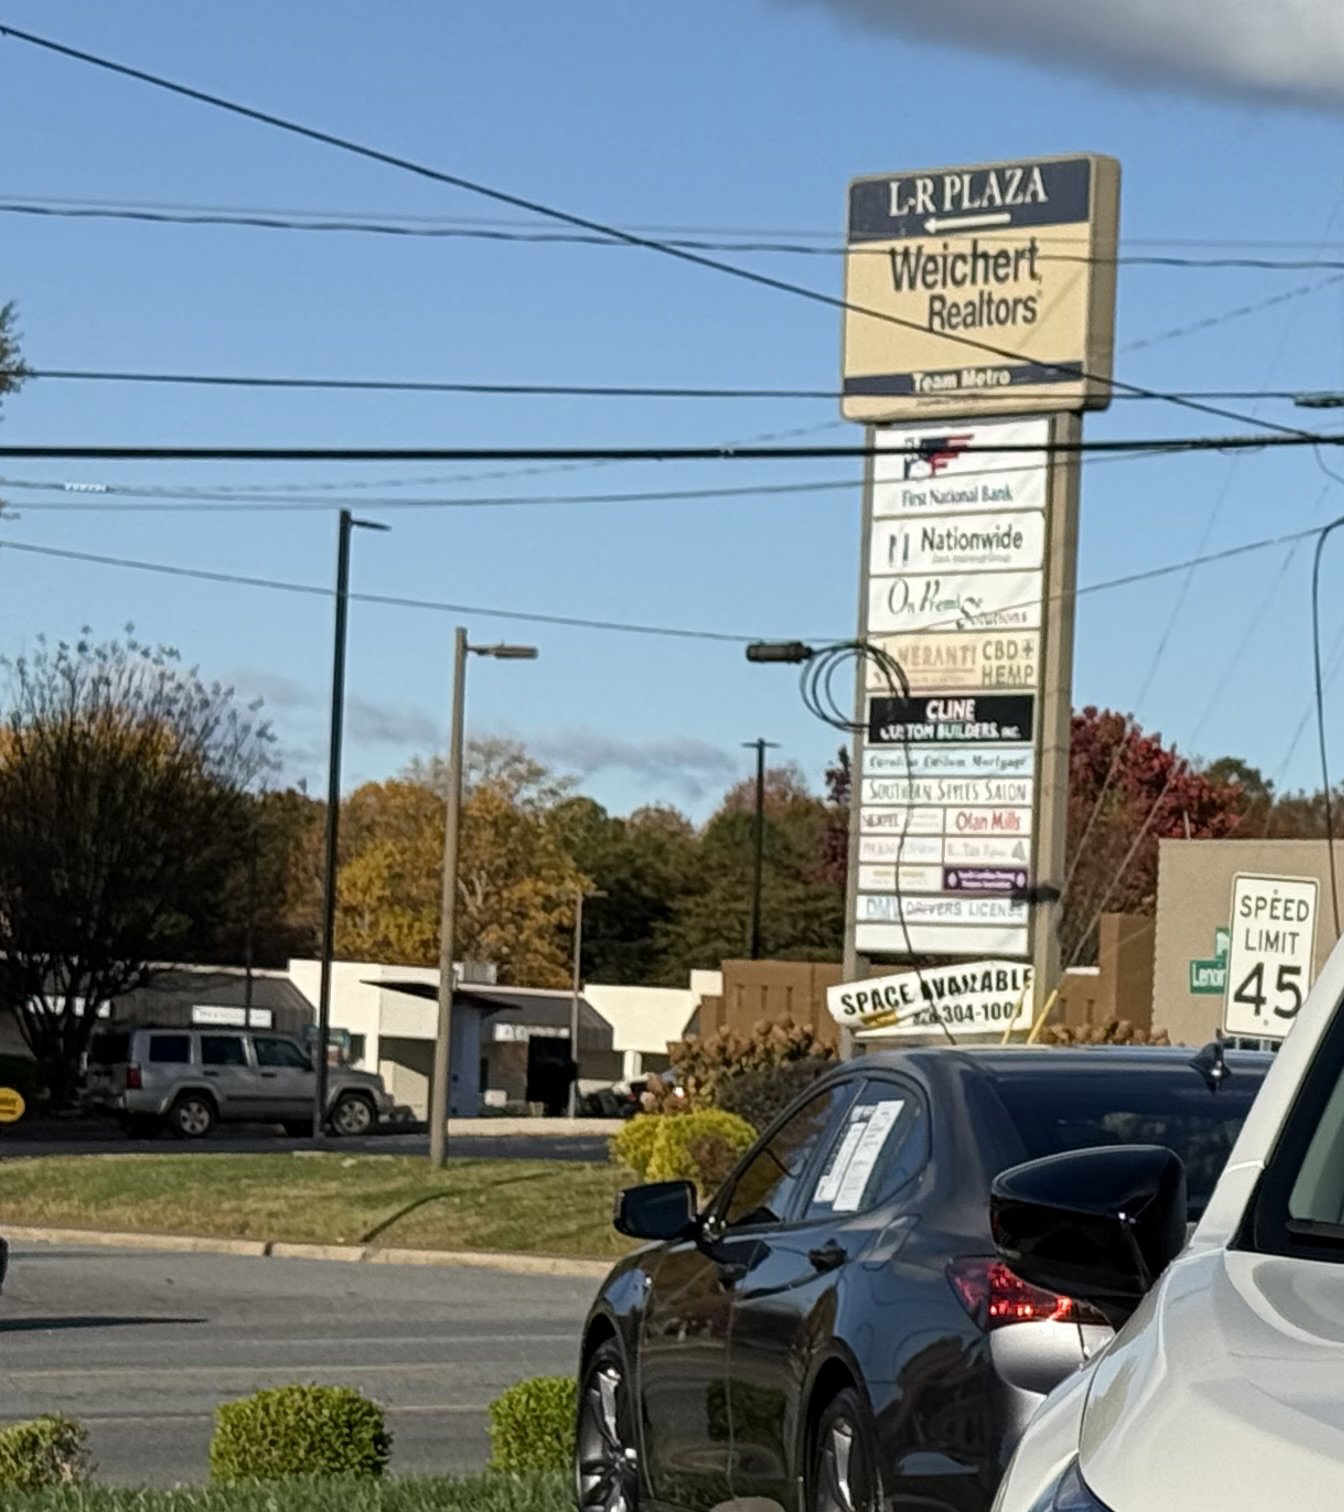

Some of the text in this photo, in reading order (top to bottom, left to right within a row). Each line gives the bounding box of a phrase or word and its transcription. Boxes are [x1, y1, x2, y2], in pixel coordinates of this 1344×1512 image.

[943, 166, 1049, 212] PLAZA
[928, 290, 1038, 333] Realtors
[912, 369, 1012, 393] Team Metro
[921, 523, 1024, 553] Nationwide
[981, 639, 1018, 662] CBD
[982, 665, 1034, 686] HEMP
[926, 699, 976, 720] CLINE
[1239, 894, 1310, 922] SPEED
[1244, 928, 1300, 955] LIMIT
[840, 983, 915, 1015] SPACE
[1233, 961, 1303, 1020] 45
